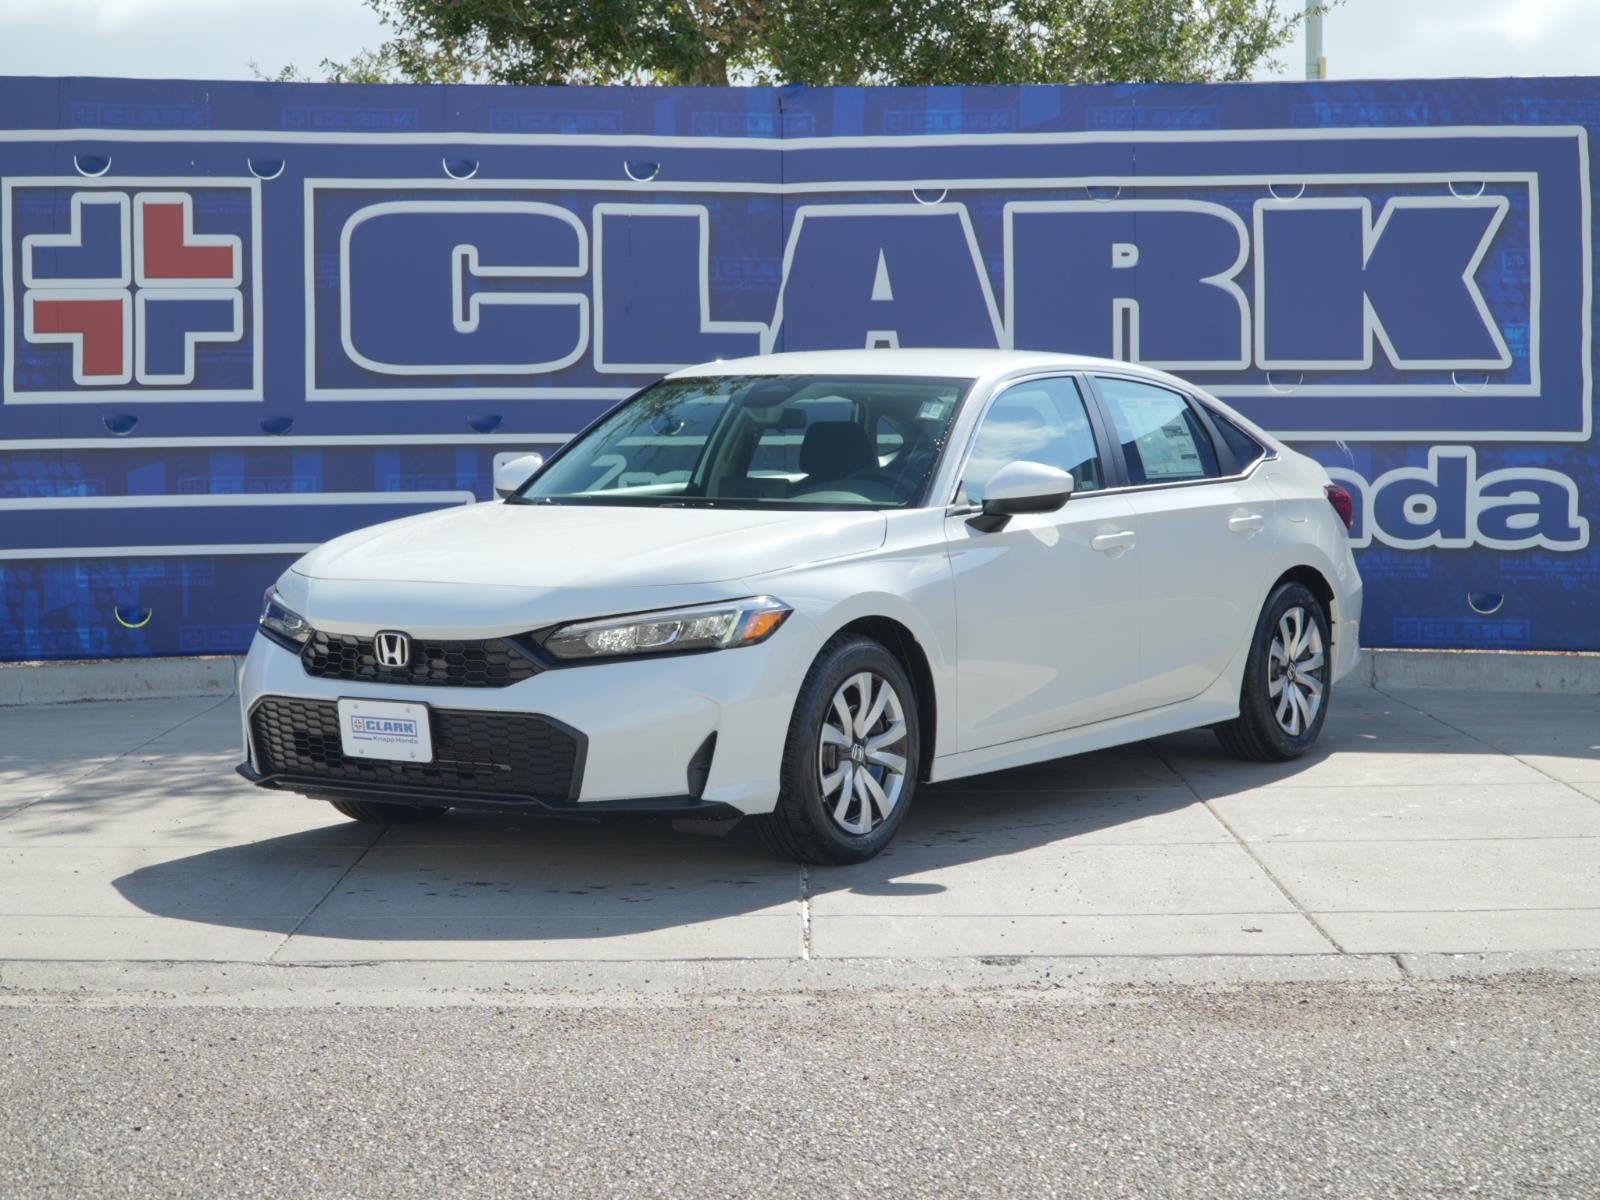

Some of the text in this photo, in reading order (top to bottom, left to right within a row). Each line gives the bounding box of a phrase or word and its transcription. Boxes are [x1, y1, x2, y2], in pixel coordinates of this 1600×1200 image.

[339, 195, 1513, 375] CLARK
[366, 720, 413, 733] CLARK
[373, 735, 395, 744] Knapp
